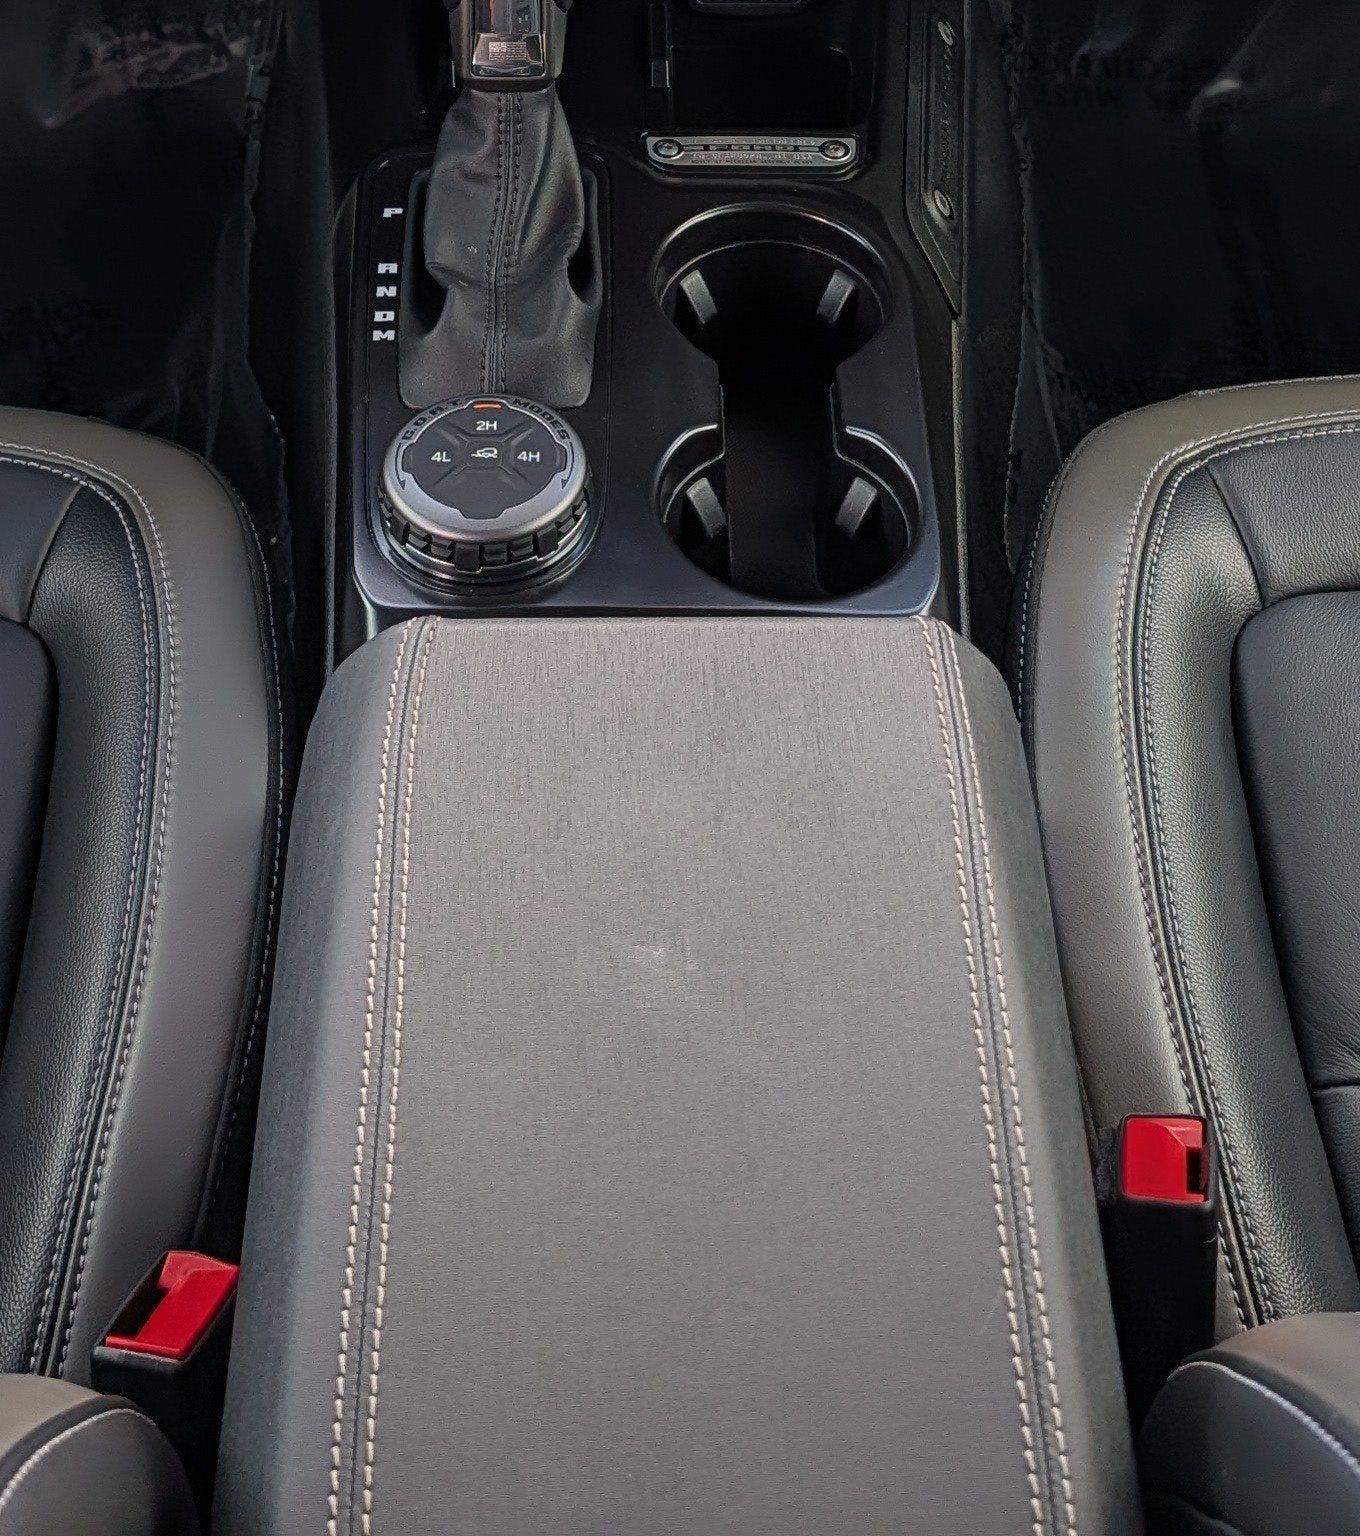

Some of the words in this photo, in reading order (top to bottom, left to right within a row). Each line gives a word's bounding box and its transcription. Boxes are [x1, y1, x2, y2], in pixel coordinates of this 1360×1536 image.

[382, 207, 403, 218] P
[377, 263, 398, 274] R
[375, 286, 397, 297] N
[373, 310, 395, 322] D
[372, 330, 395, 341] M
[512, 398, 571, 441] MODES
[475, 420, 498, 431] 2H
[430, 451, 452, 463] 4L
[516, 451, 541, 462] 4H
